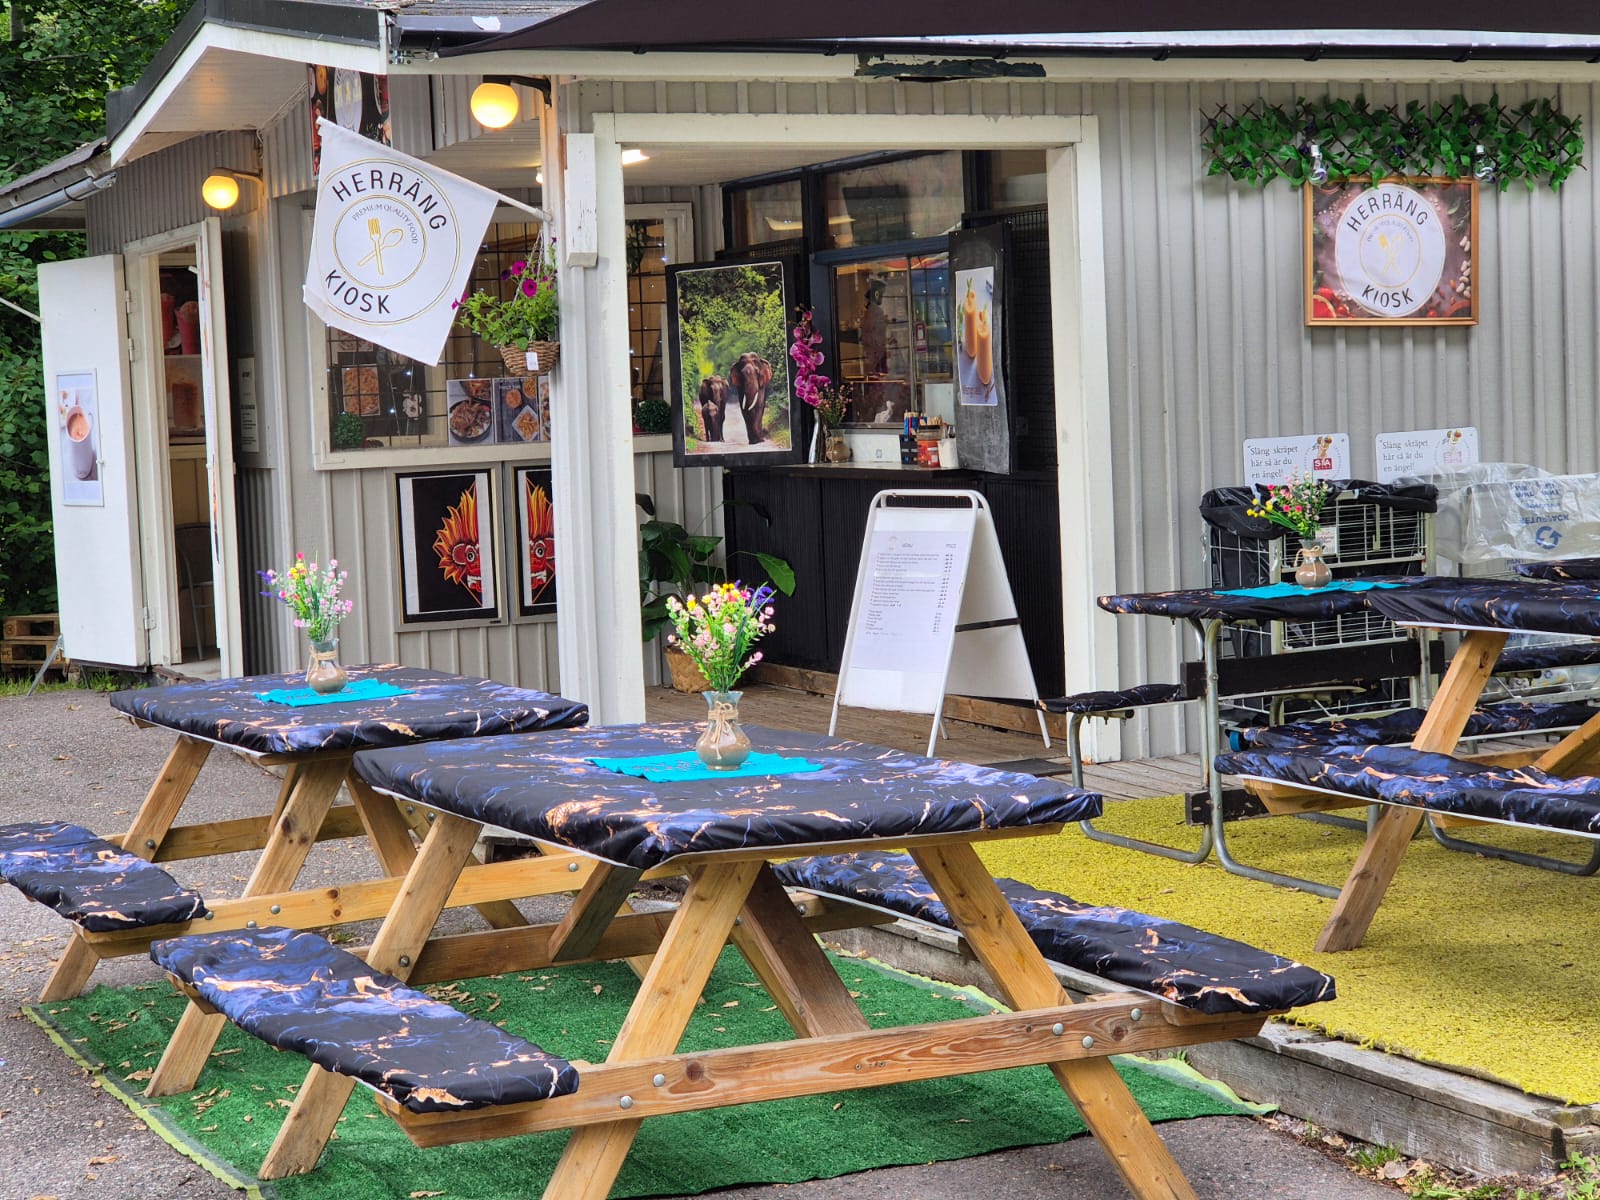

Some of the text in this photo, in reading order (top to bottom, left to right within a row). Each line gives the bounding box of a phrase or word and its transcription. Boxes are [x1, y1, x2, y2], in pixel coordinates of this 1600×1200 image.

[332, 169, 447, 230] HERRÄNG
[1346, 191, 1428, 232] HERRÄNG
[352, 203, 418, 244] PREMIUM QUALITY FOOD
[325, 269, 391, 314] KIOSK
[1362, 284, 1414, 308] KIOSK
[1283, 456, 1292, 465] du
[1414, 450, 1424, 459] du
